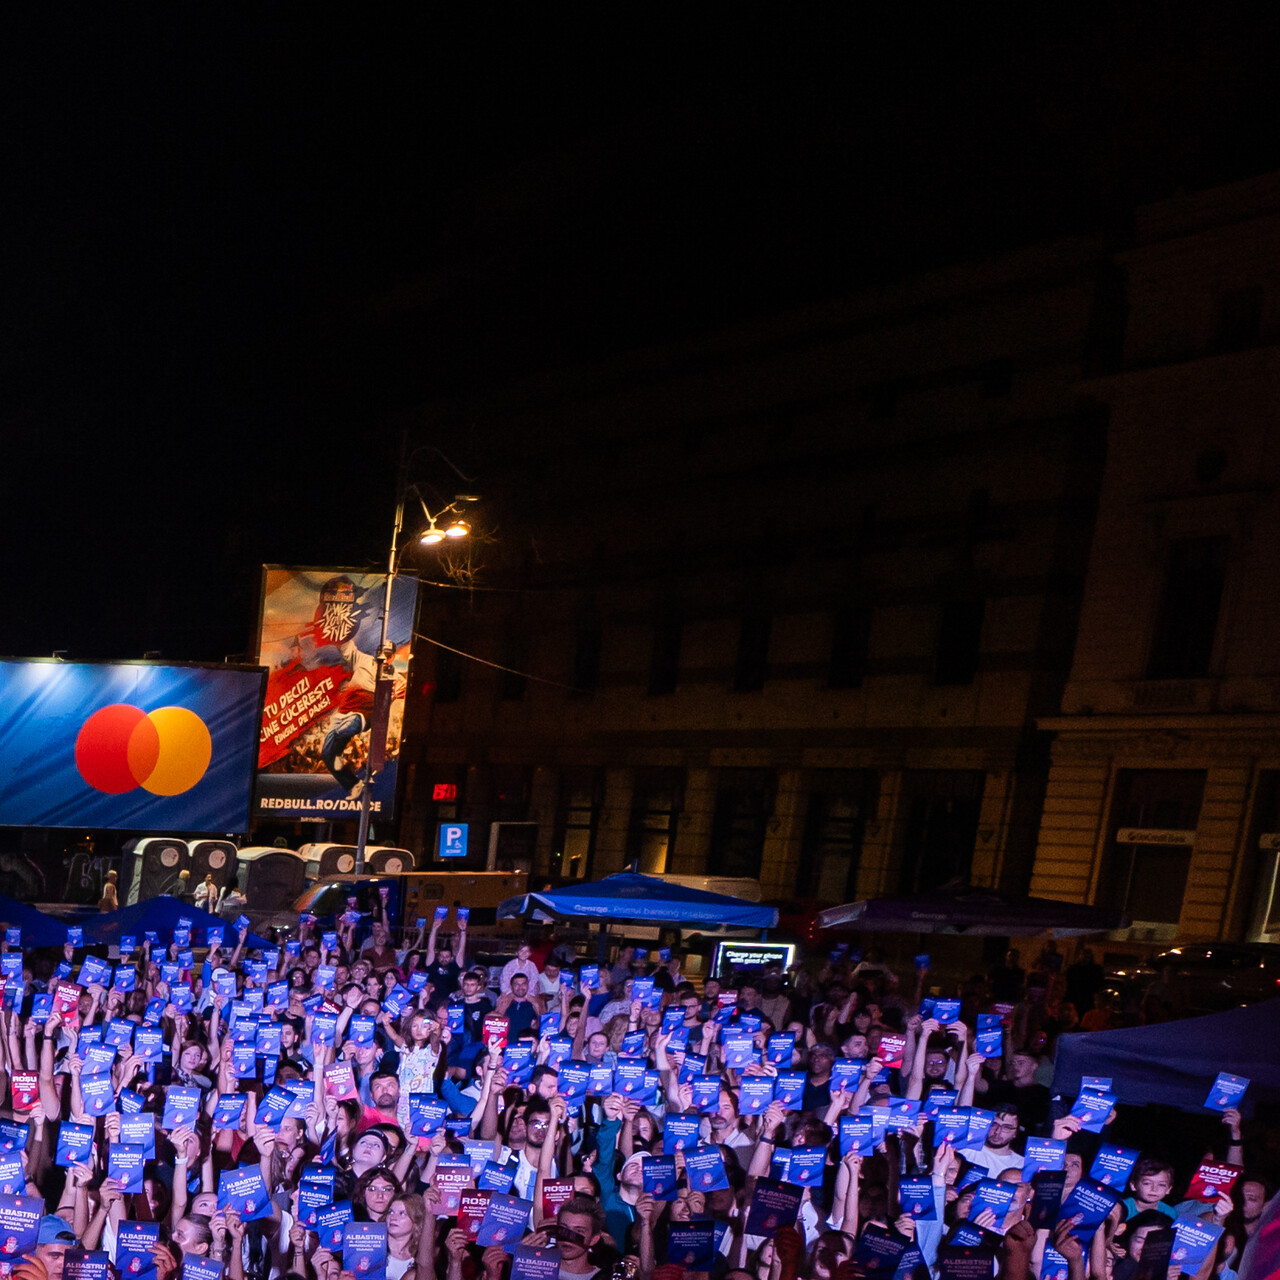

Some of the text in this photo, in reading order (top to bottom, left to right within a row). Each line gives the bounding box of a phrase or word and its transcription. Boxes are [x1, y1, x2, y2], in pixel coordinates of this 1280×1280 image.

[263, 677, 310, 719] TU DECIZI
[274, 694, 332, 746] RINGUL DE DANS!
[446, 827, 462, 846] P
[749, 952, 763, 960] your
[763, 952, 784, 960] phone
[436, 1174, 470, 1184] ROȘU
[544, 1184, 573, 1194] ROȘU
[119, 1232, 157, 1241] ALBASTRU
